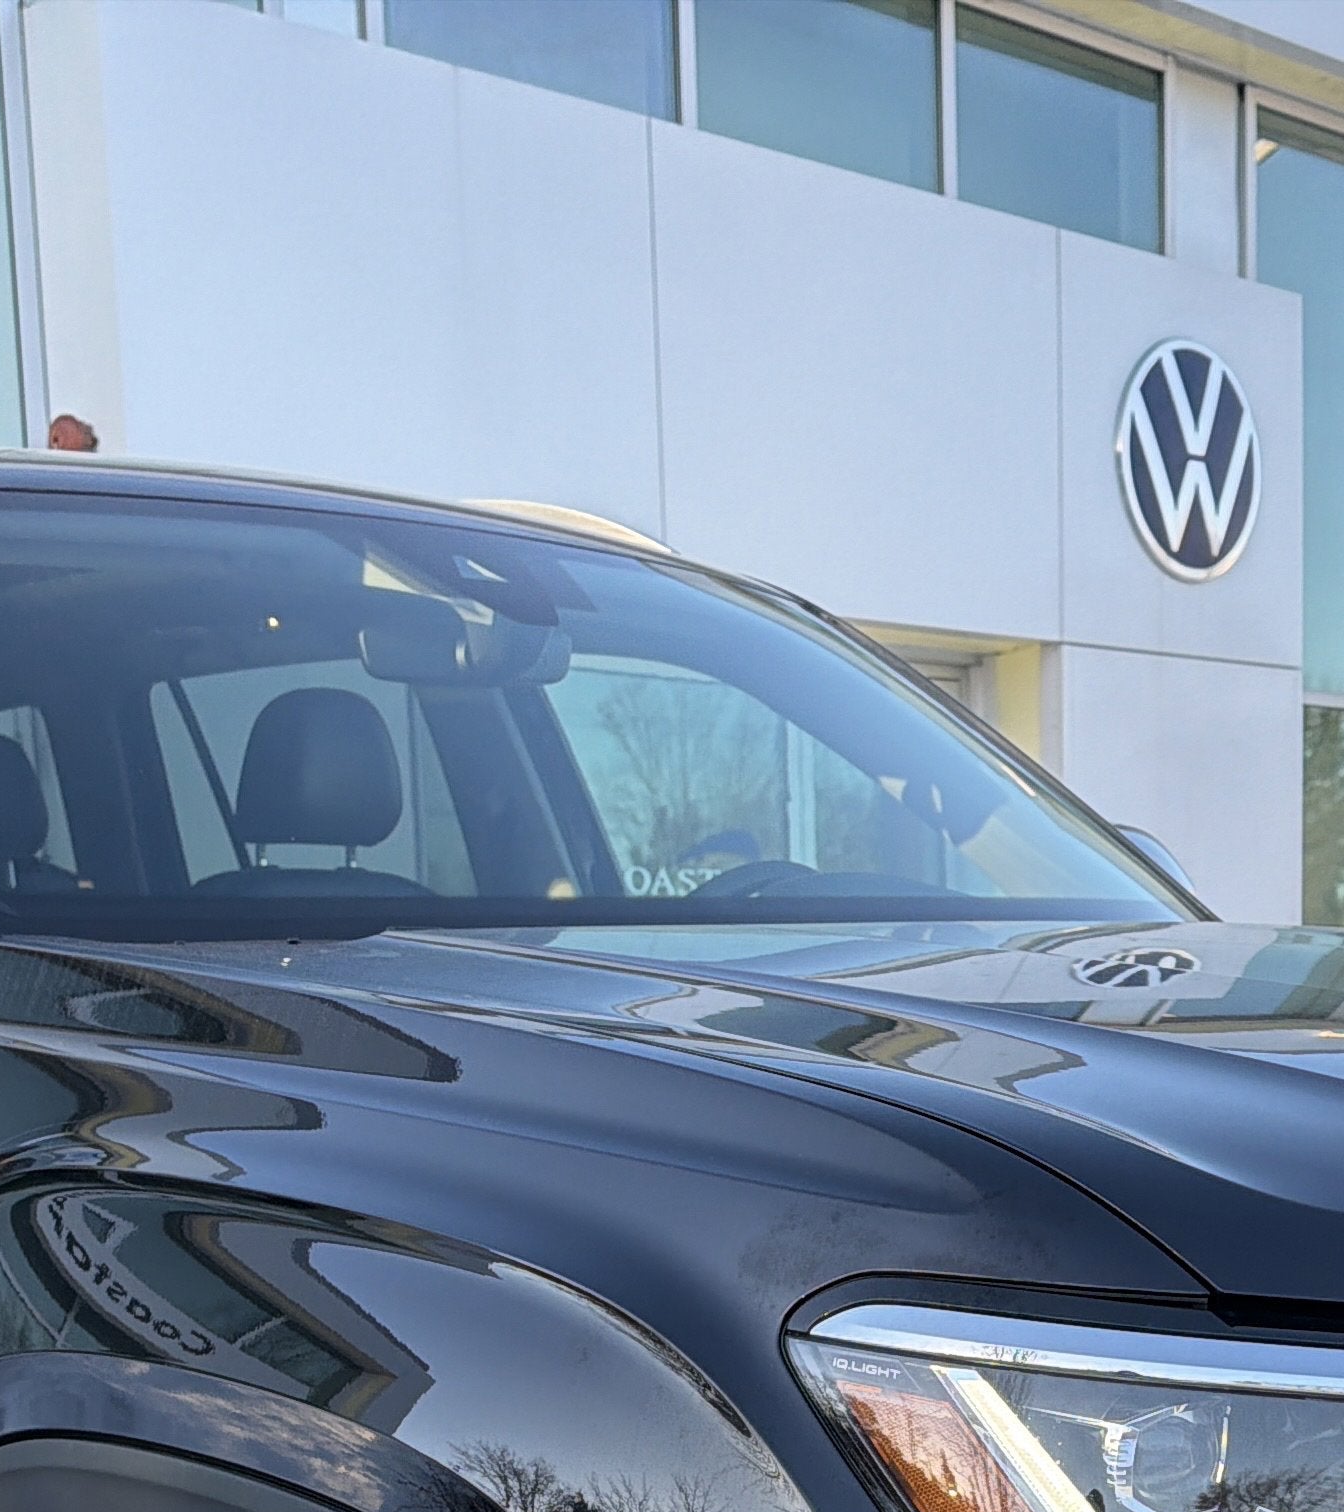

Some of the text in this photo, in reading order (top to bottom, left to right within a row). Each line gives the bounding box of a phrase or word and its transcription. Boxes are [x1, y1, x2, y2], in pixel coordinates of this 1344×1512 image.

[1124, 342, 1257, 565] VW
[623, 866, 723, 897] OAST
[832, 1356, 901, 1380] IQ.LIGHT
